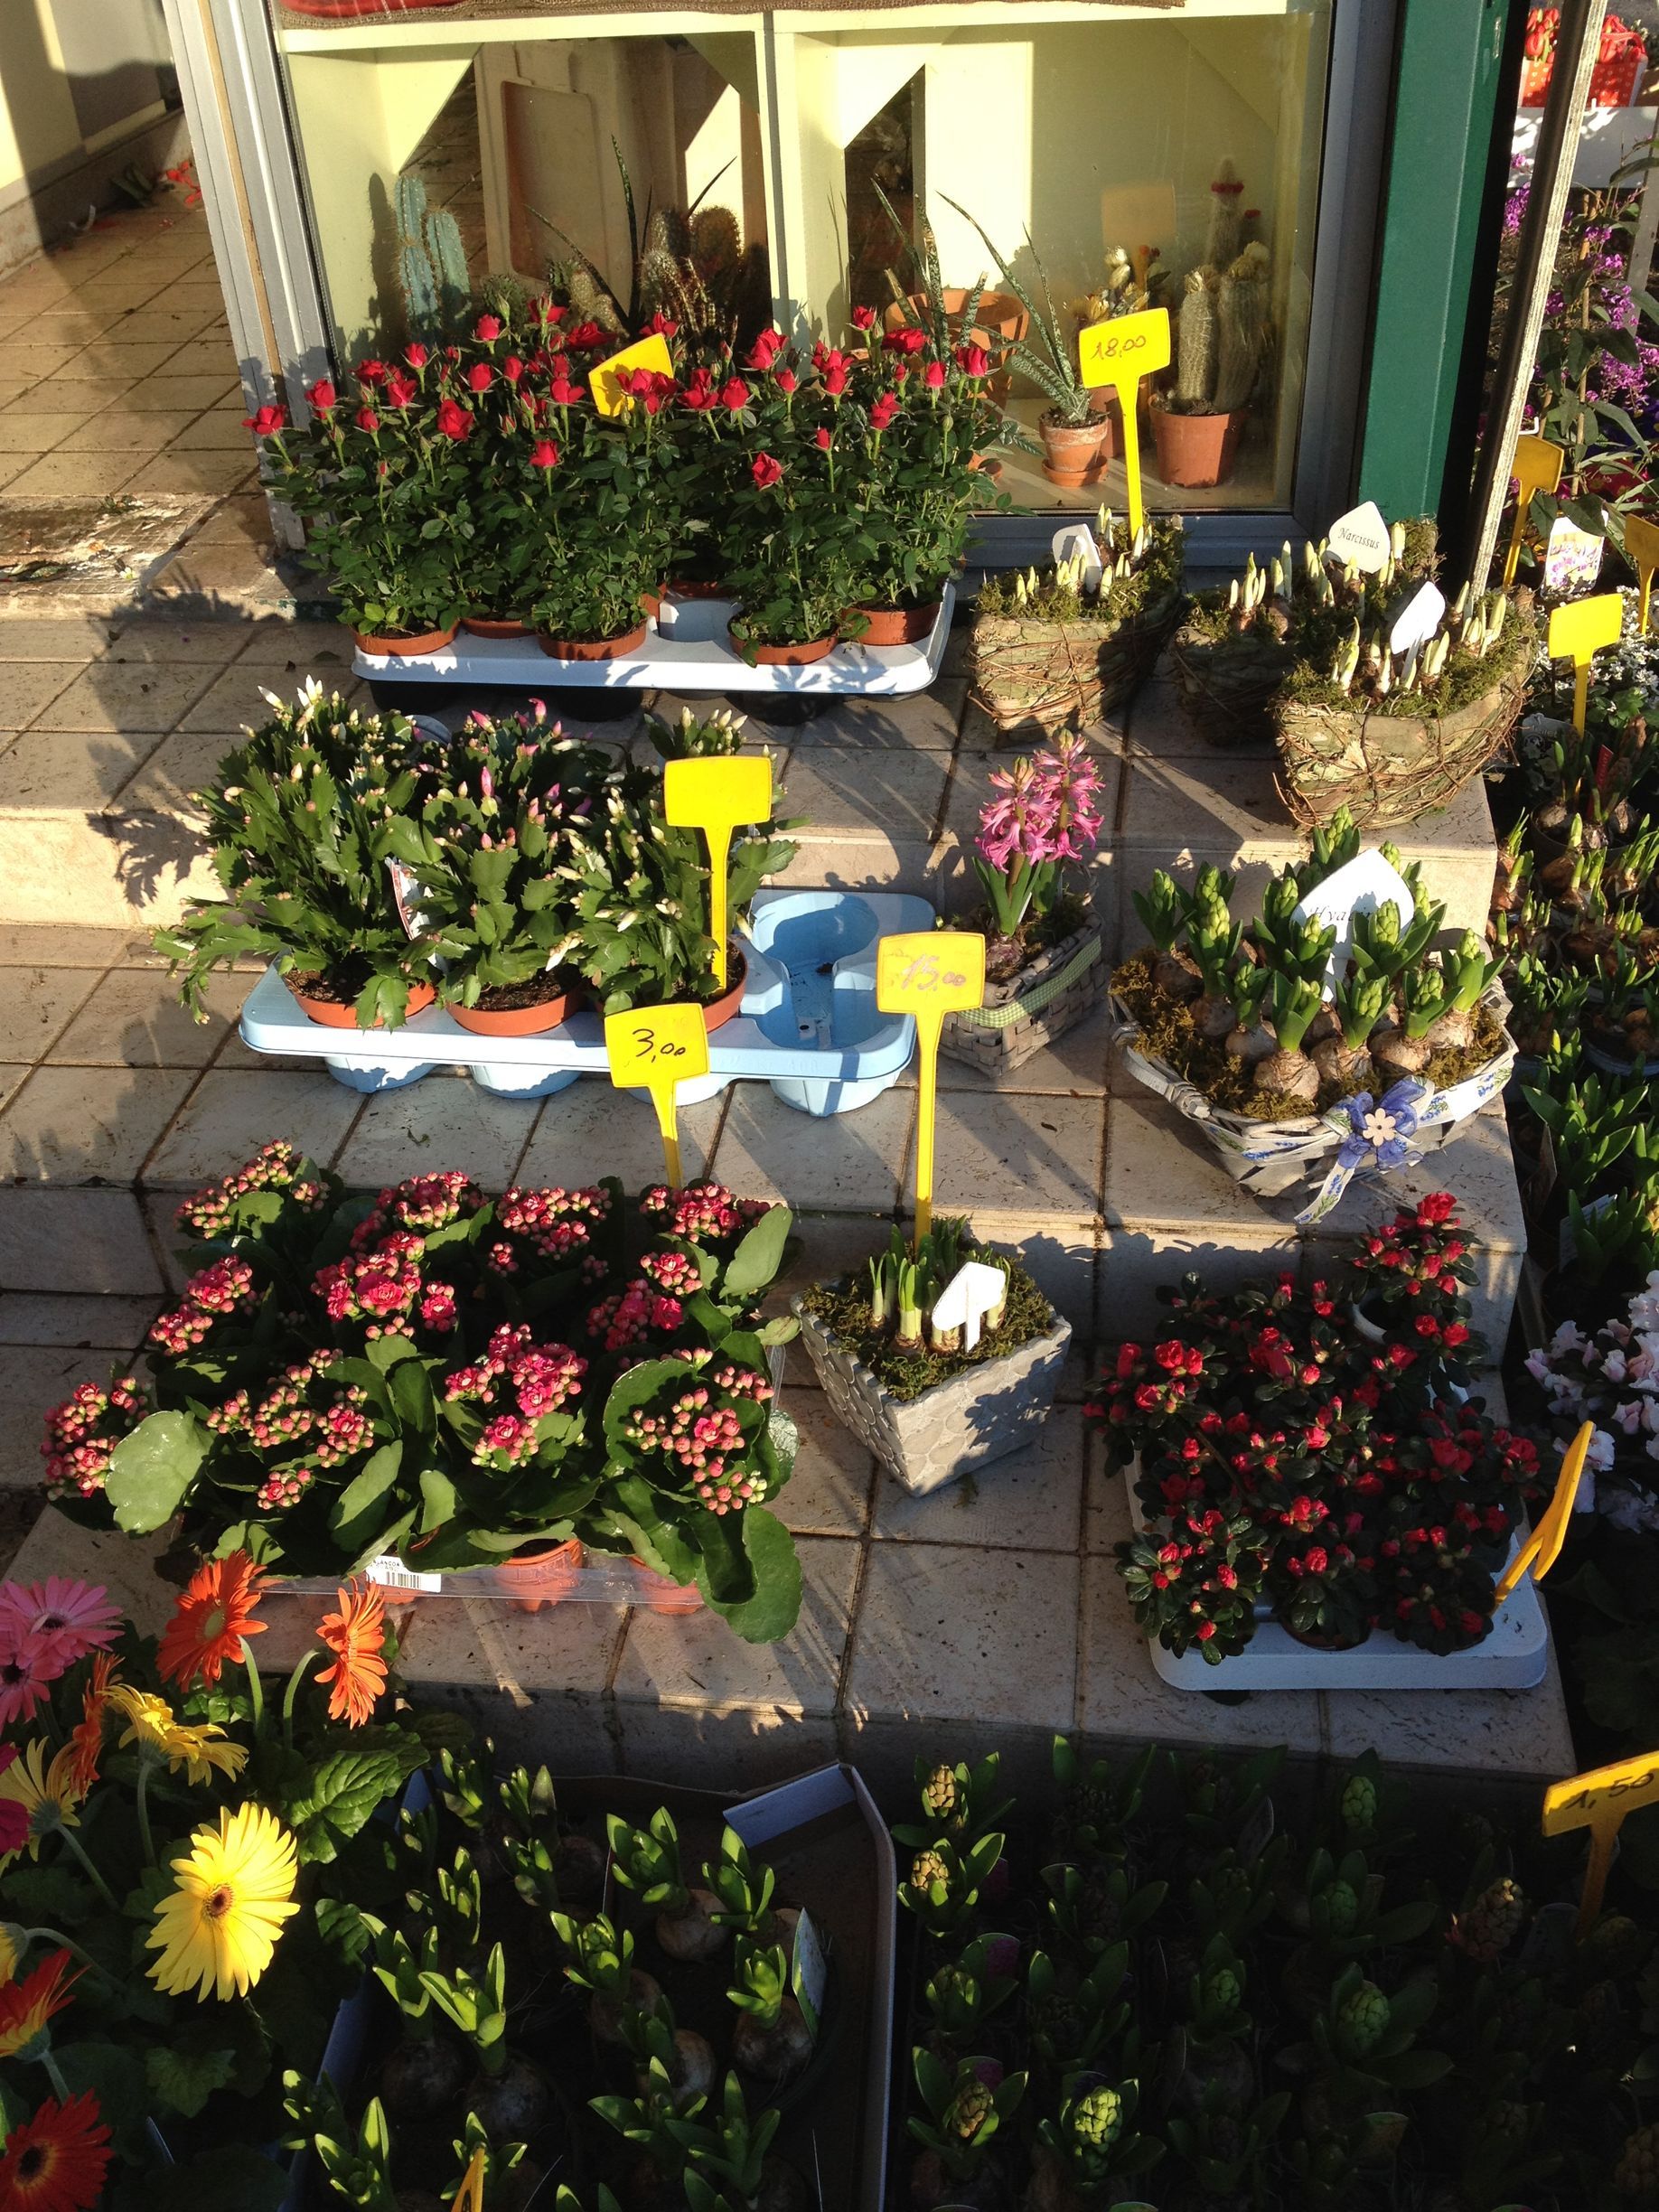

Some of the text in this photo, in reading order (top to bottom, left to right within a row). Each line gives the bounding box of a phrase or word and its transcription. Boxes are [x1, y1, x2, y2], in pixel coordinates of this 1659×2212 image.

[1090, 334, 1147, 361] 18,00
[1337, 527, 1380, 549] Narcissus
[632, 1027, 686, 1063] 3,00
[1564, 1772, 1654, 1810] 1,50
